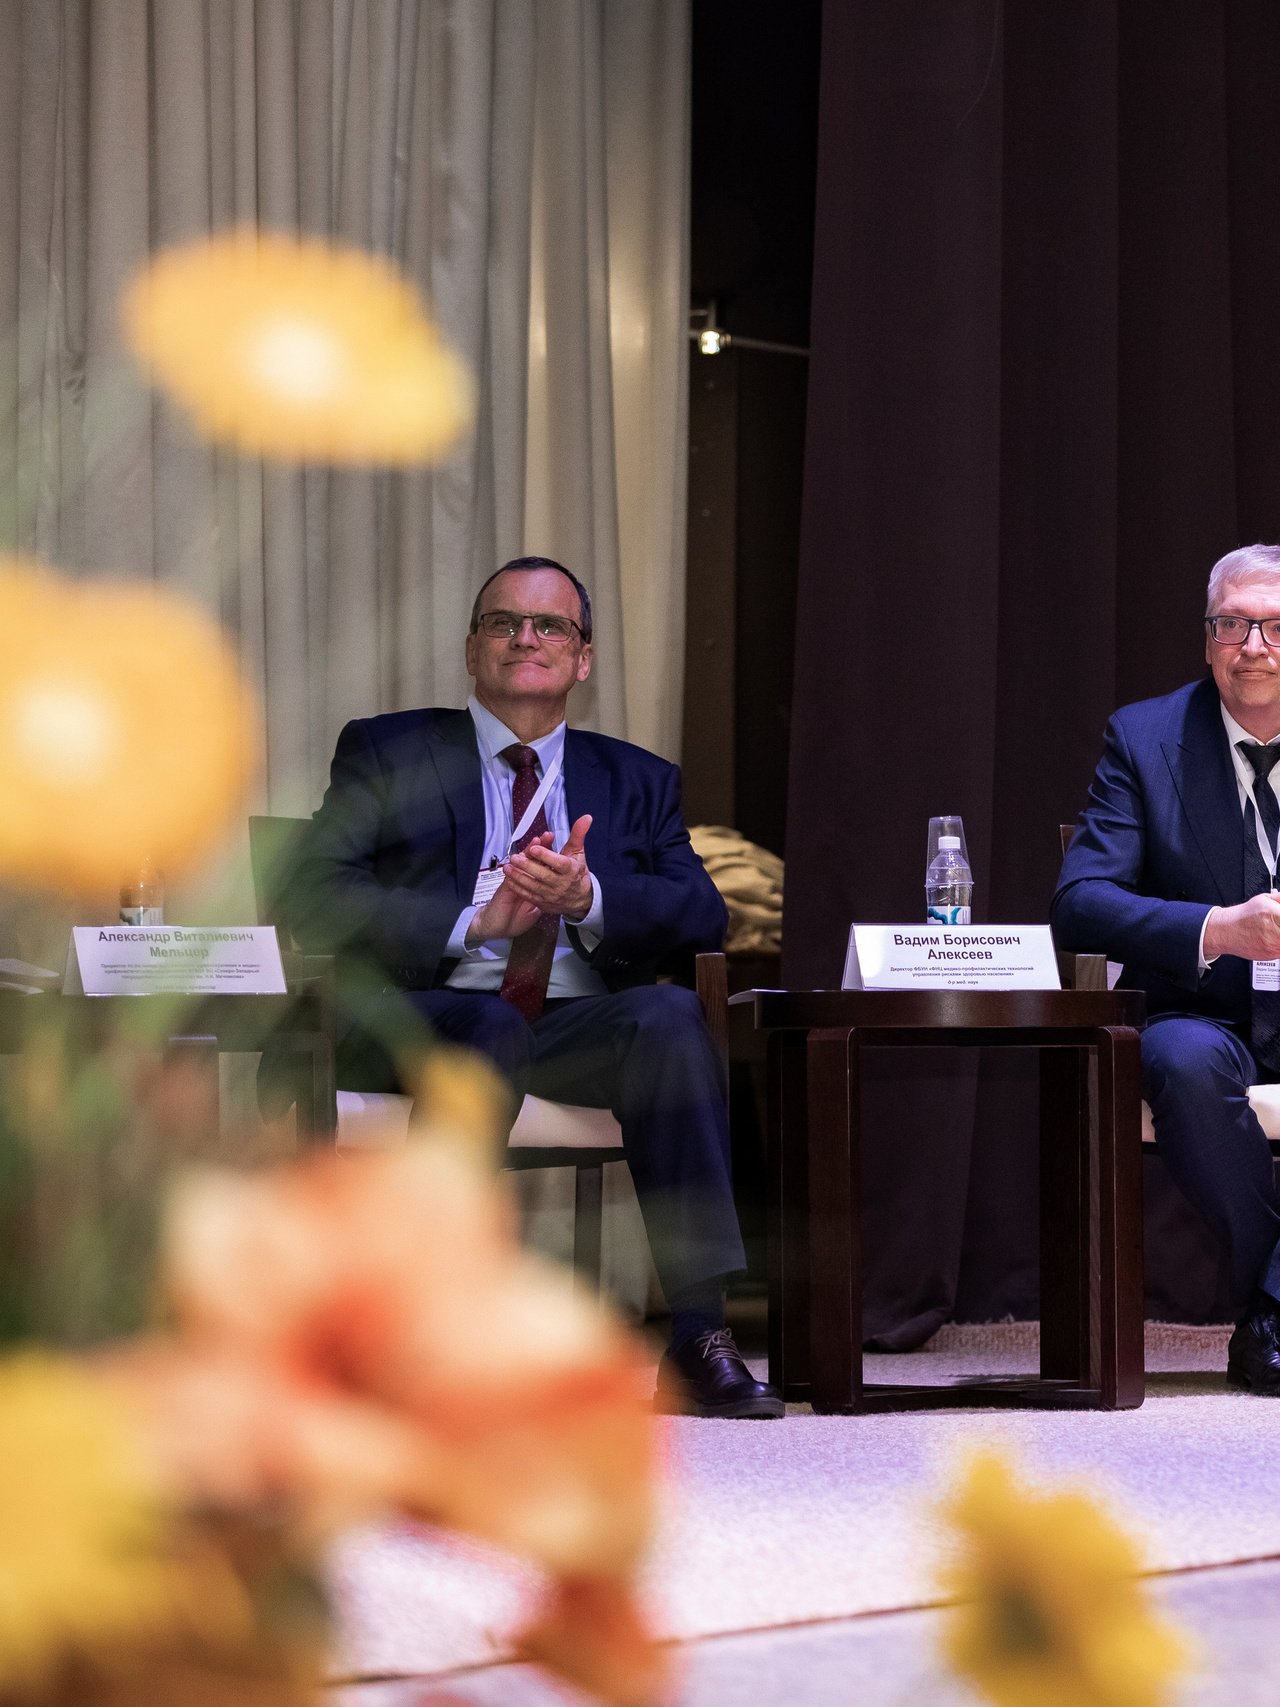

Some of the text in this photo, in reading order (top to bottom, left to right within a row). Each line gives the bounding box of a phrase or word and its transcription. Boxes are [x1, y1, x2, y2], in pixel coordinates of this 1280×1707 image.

[98, 930, 254, 944] Александр Виталиевич
[894, 934, 1020, 947] Вадим Борисович
[150, 946, 209, 960] Мельцер
[927, 948, 993, 960] Алексеев
